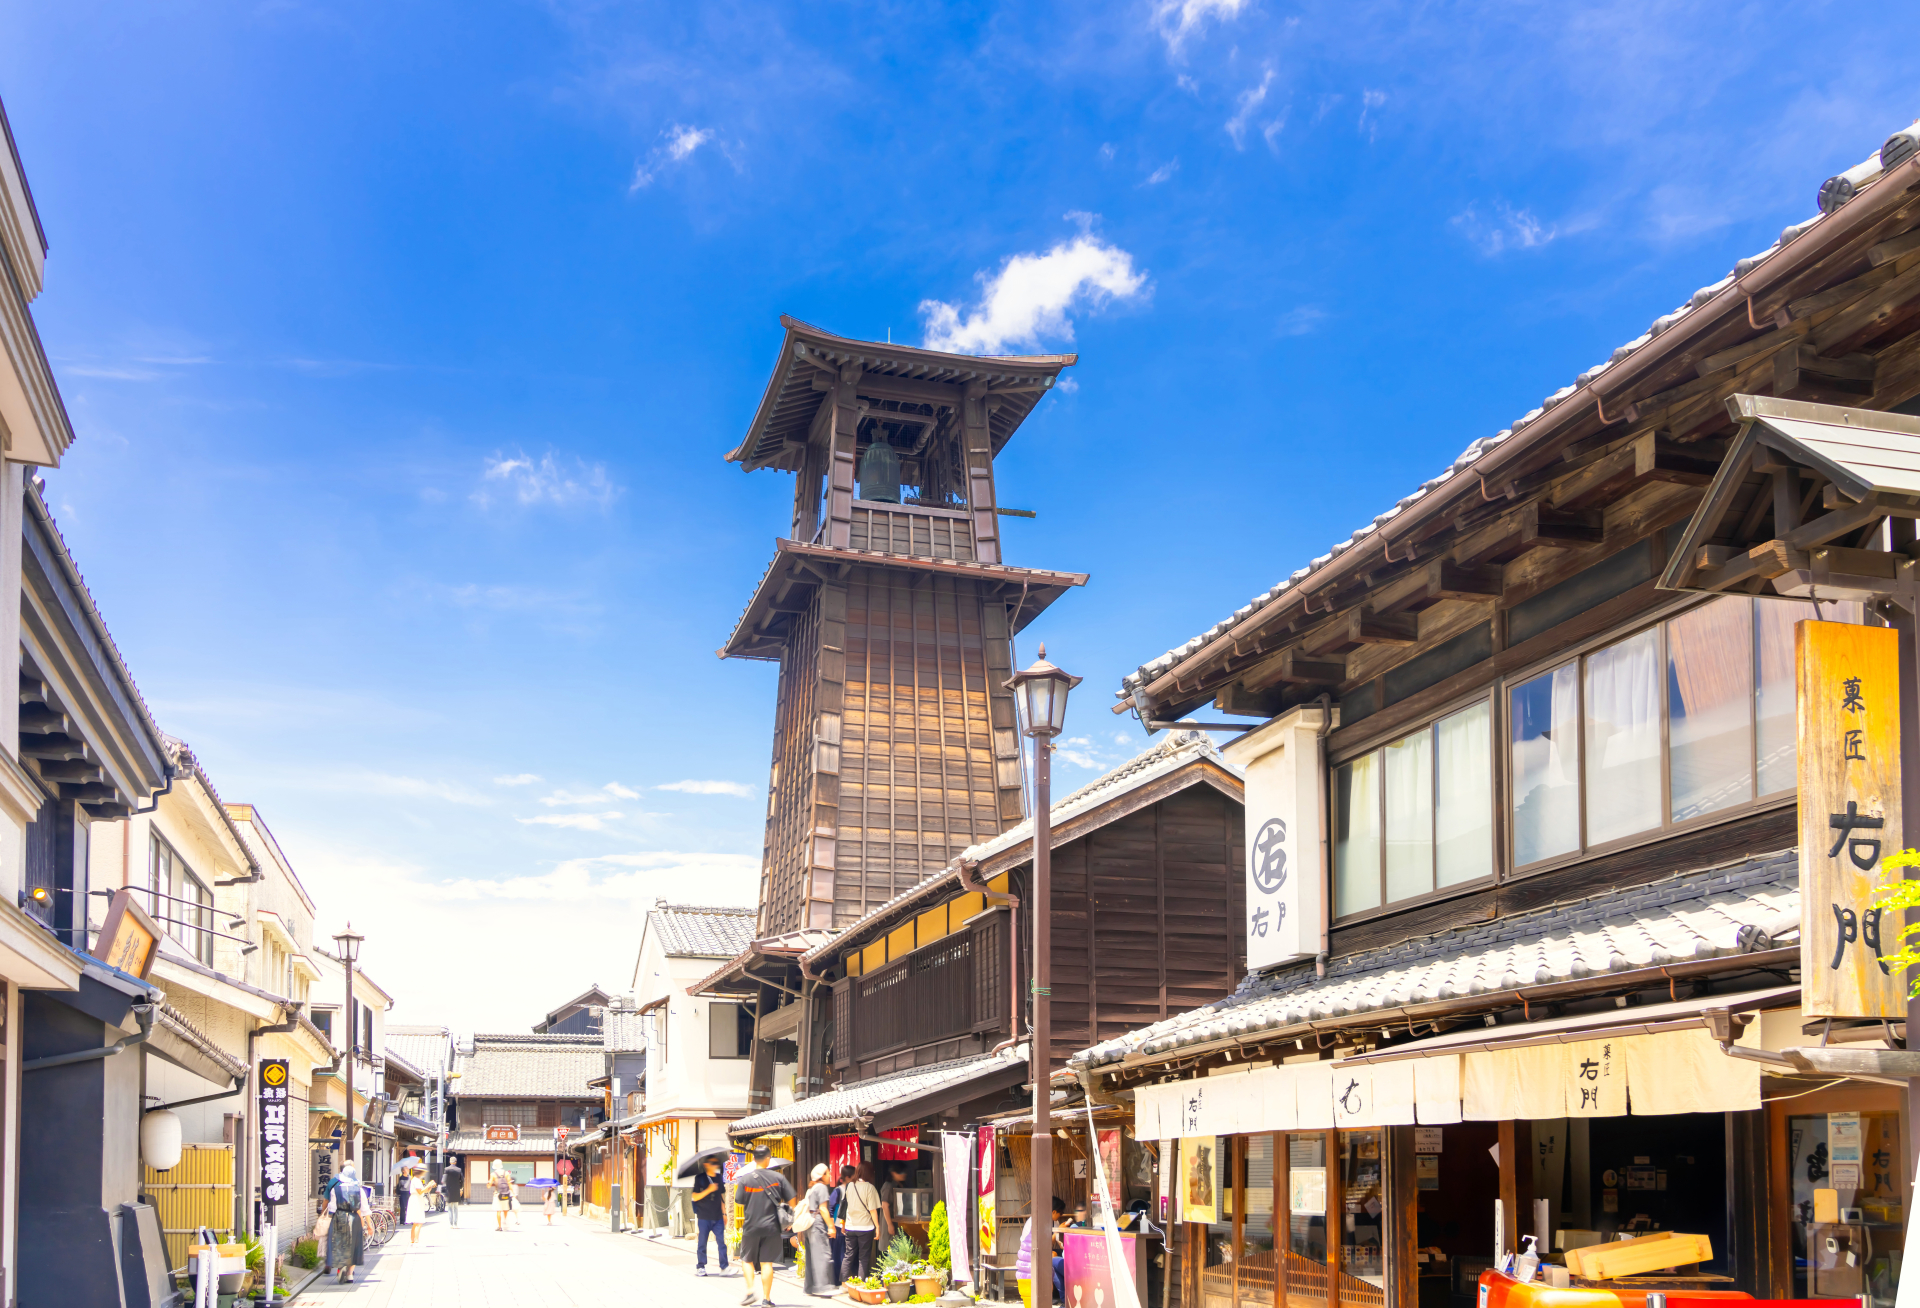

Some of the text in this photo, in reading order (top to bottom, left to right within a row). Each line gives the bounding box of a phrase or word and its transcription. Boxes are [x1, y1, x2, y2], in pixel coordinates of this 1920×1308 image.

[1827, 676, 1890, 976] 菓匠 右門
[1579, 1057, 1599, 1110] 右門
[1188, 1097, 1198, 1132] 右門
[264, 1104, 285, 1201] 江戸文字や
[1872, 1149, 1893, 1192] 右門
